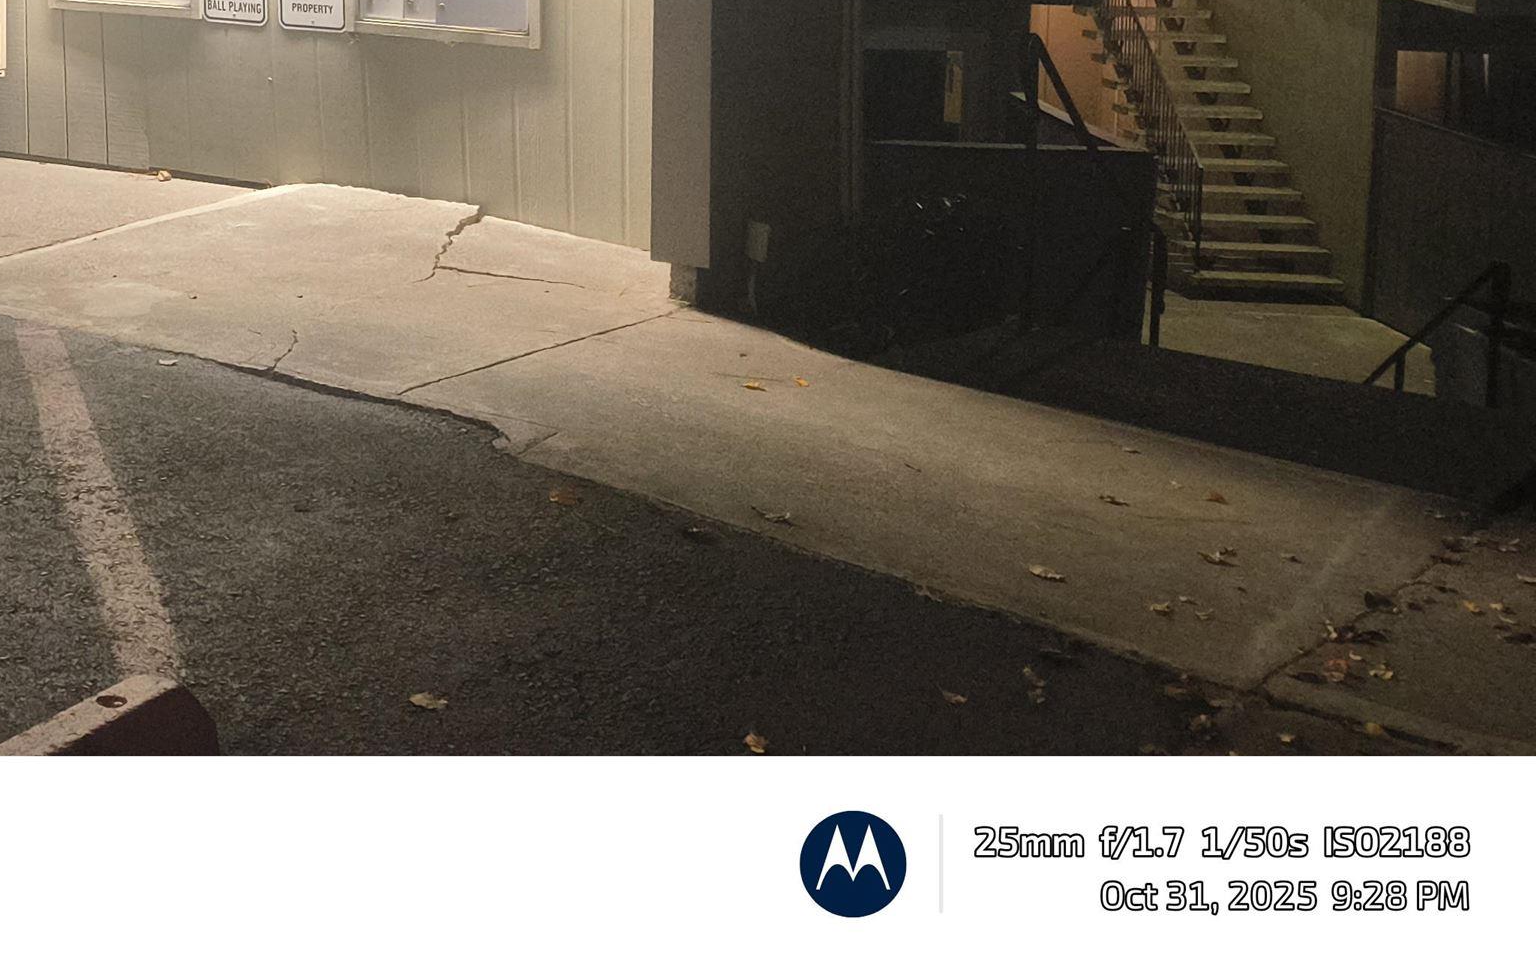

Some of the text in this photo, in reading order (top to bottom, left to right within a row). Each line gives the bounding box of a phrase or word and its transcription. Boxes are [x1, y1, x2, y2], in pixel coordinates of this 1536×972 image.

[207, 0, 262, 14] BALL PLAYING
[291, 2, 333, 14] PROPERTY
